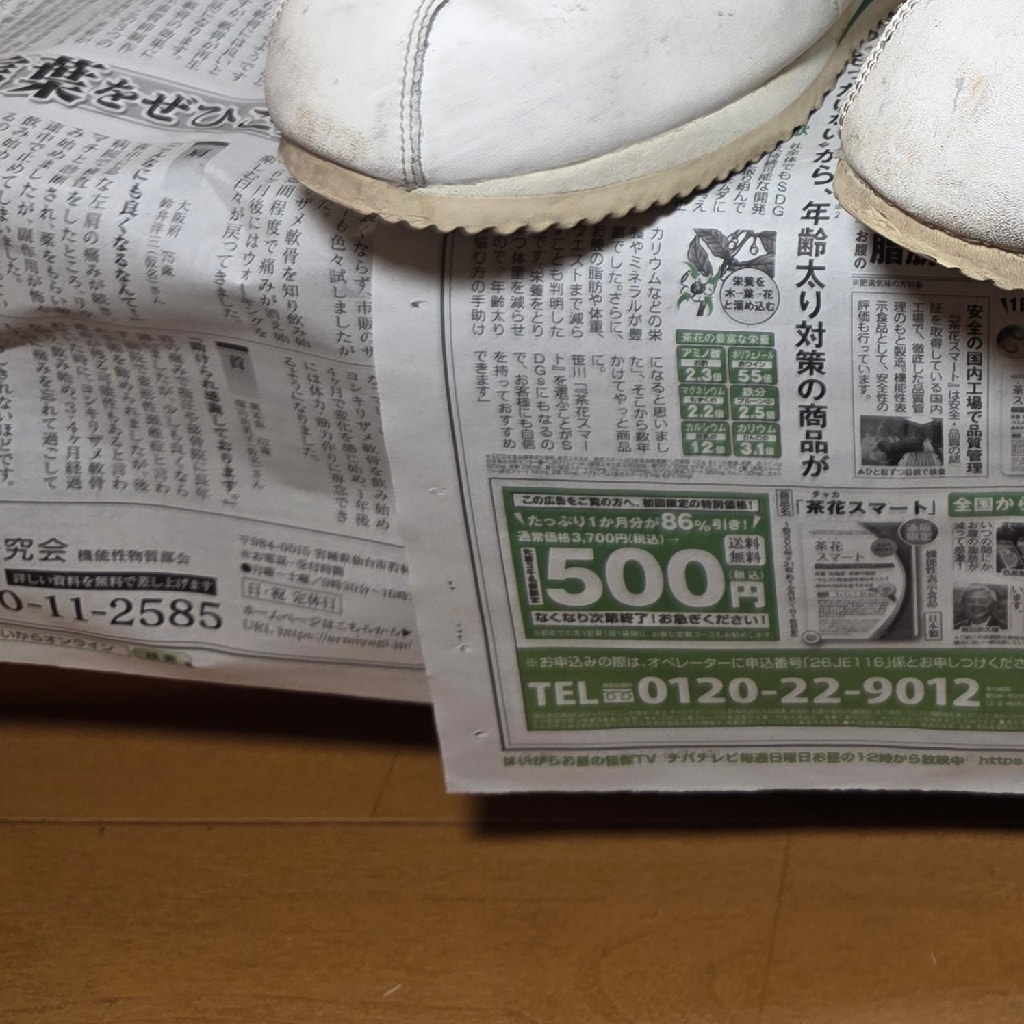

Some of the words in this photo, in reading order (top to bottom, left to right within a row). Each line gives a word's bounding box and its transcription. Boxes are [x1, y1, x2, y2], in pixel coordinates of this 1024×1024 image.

[853, 230, 868, 269] お腹の
[647, 226, 664, 342] カリウムなどの栄
[732, 276, 766, 288] 栄養を
[681, 332, 770, 346] 茶花の豊富な栄養
[681, 347, 722, 359] アミノ酸
[857, 299, 871, 400] 評価も行っています。
[929, 302, 943, 415] 証を取得している国内
[493, 351, 517, 449] を持っておすすめ
[610, 356, 632, 453] かけてやっと商品
[649, 356, 670, 453] になると思いまし
[966, 303, 983, 475] 安全の国内工場で品質管理
[736, 424, 777, 434] カリウム
[738, 406, 776, 420] 2.5倍
[690, 441, 726, 454] 12倍
[740, 442, 775, 455] 3.1倍
[77, 549, 192, 567] 機能性物質部会
[727, 536, 760, 550] 送料
[729, 550, 761, 564] 無料
[546, 546, 767, 609] 500円
[527, 680, 599, 707] TEL
[637, 675, 981, 708] 0120-22-9012
